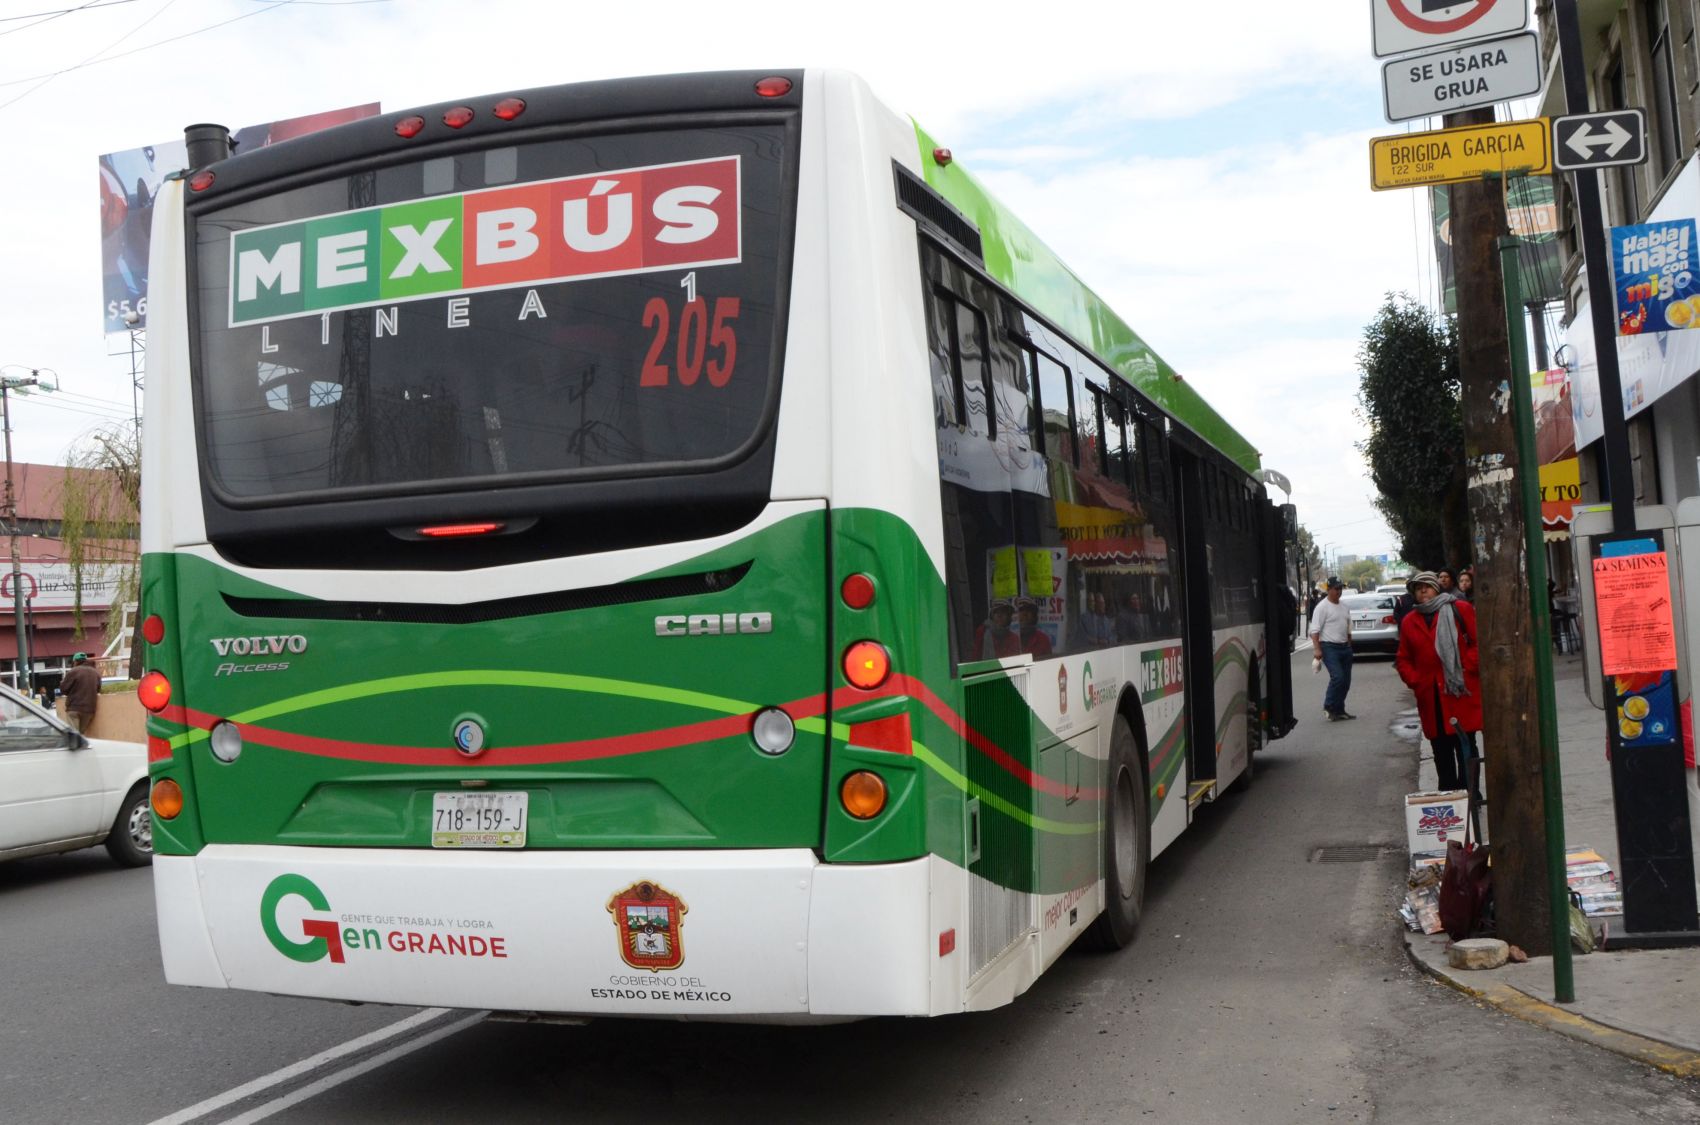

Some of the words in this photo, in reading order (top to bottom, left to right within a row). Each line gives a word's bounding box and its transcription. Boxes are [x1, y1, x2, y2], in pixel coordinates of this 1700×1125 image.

[1410, 64, 1434, 83] SE
[1440, 49, 1508, 77] USARA
[1434, 77, 1489, 101] GRUA
[1391, 141, 1452, 166] BRIGIDA
[1463, 133, 1525, 157] GARCIA
[1391, 165, 1409, 175] 122
[1415, 162, 1434, 173] SUR
[238, 180, 723, 303] MEXBÚS
[1623, 227, 1679, 254] Habla
[1662, 260, 1689, 275] con
[680, 271, 697, 303] 1
[1626, 271, 1692, 303] migo
[640, 297, 741, 388] 205
[1611, 556, 1667, 573] SEMINSA
[40, 580, 58, 592] Luz
[655, 612, 772, 636] CAIO
[210, 635, 307, 656] VOLVO
[214, 662, 290, 677] Access
[1142, 649, 1183, 693] MEXBÚS
[436, 808, 523, 831] 718-159-J
[341, 914, 372, 924] GENTE
[375, 915, 396, 925] QUE
[398, 916, 445, 927] TRABAJA
[447, 919, 454, 928] Y
[457, 920, 494, 929] LOGRA
[387, 931, 508, 959] GRANDE
[609, 975, 677, 987] GOBIERNO
[680, 976, 706, 988] DEL
[591, 988, 647, 1000] ESTADO
[651, 990, 671, 1001] DE
[674, 988, 732, 1002] MÉXICO
